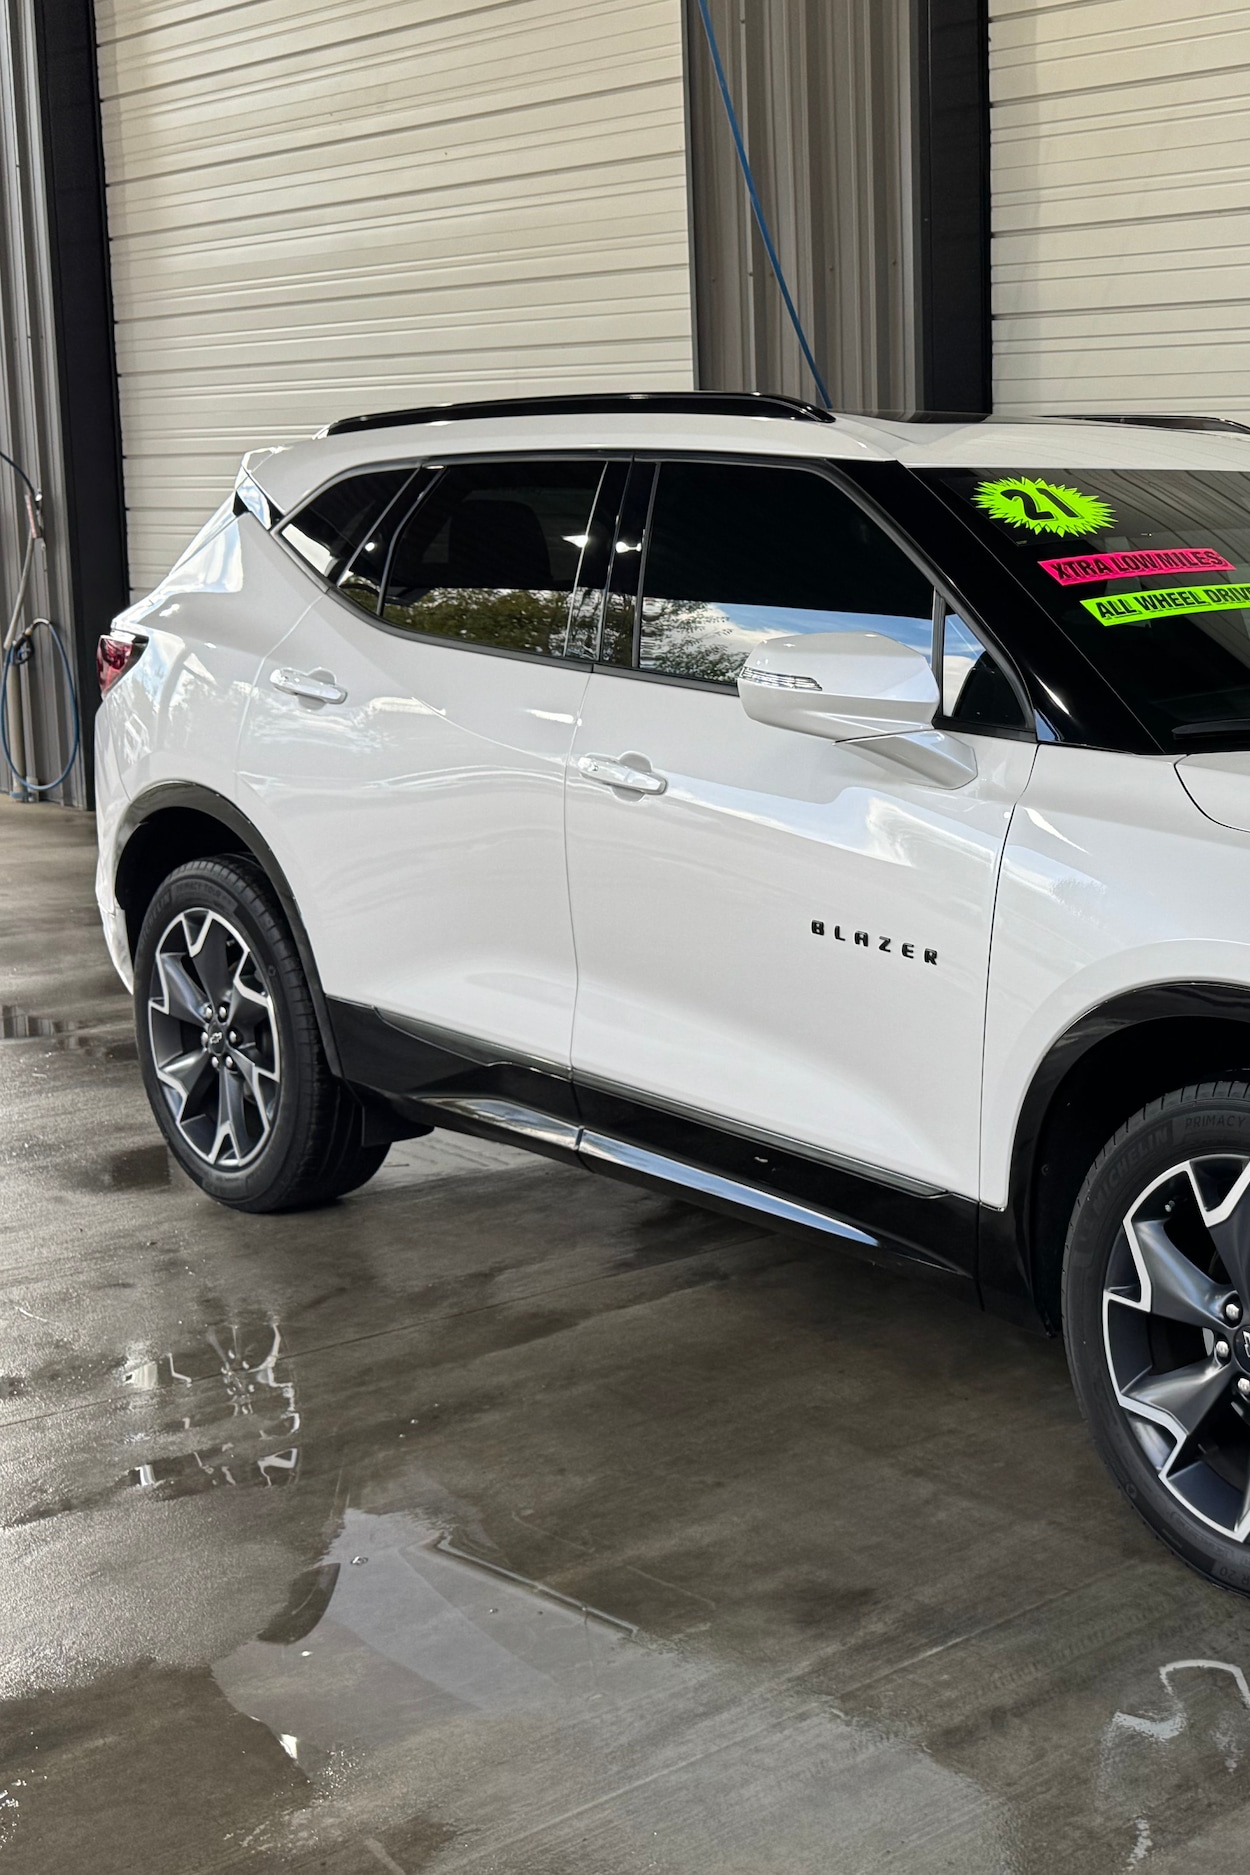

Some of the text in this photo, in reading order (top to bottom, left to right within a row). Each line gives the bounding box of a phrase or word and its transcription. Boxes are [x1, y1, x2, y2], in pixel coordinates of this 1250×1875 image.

[1000, 487, 1078, 521] 21
[1050, 558, 1113, 580] XTRA
[1156, 550, 1224, 569] MILES
[1095, 598, 1137, 619] ALL
[1134, 590, 1202, 611] WHEEL
[811, 919, 938, 966] BLAZER
[1184, 1114, 1247, 1130] PRIMACY
[1218, 1566, 1236, 1582] 20
